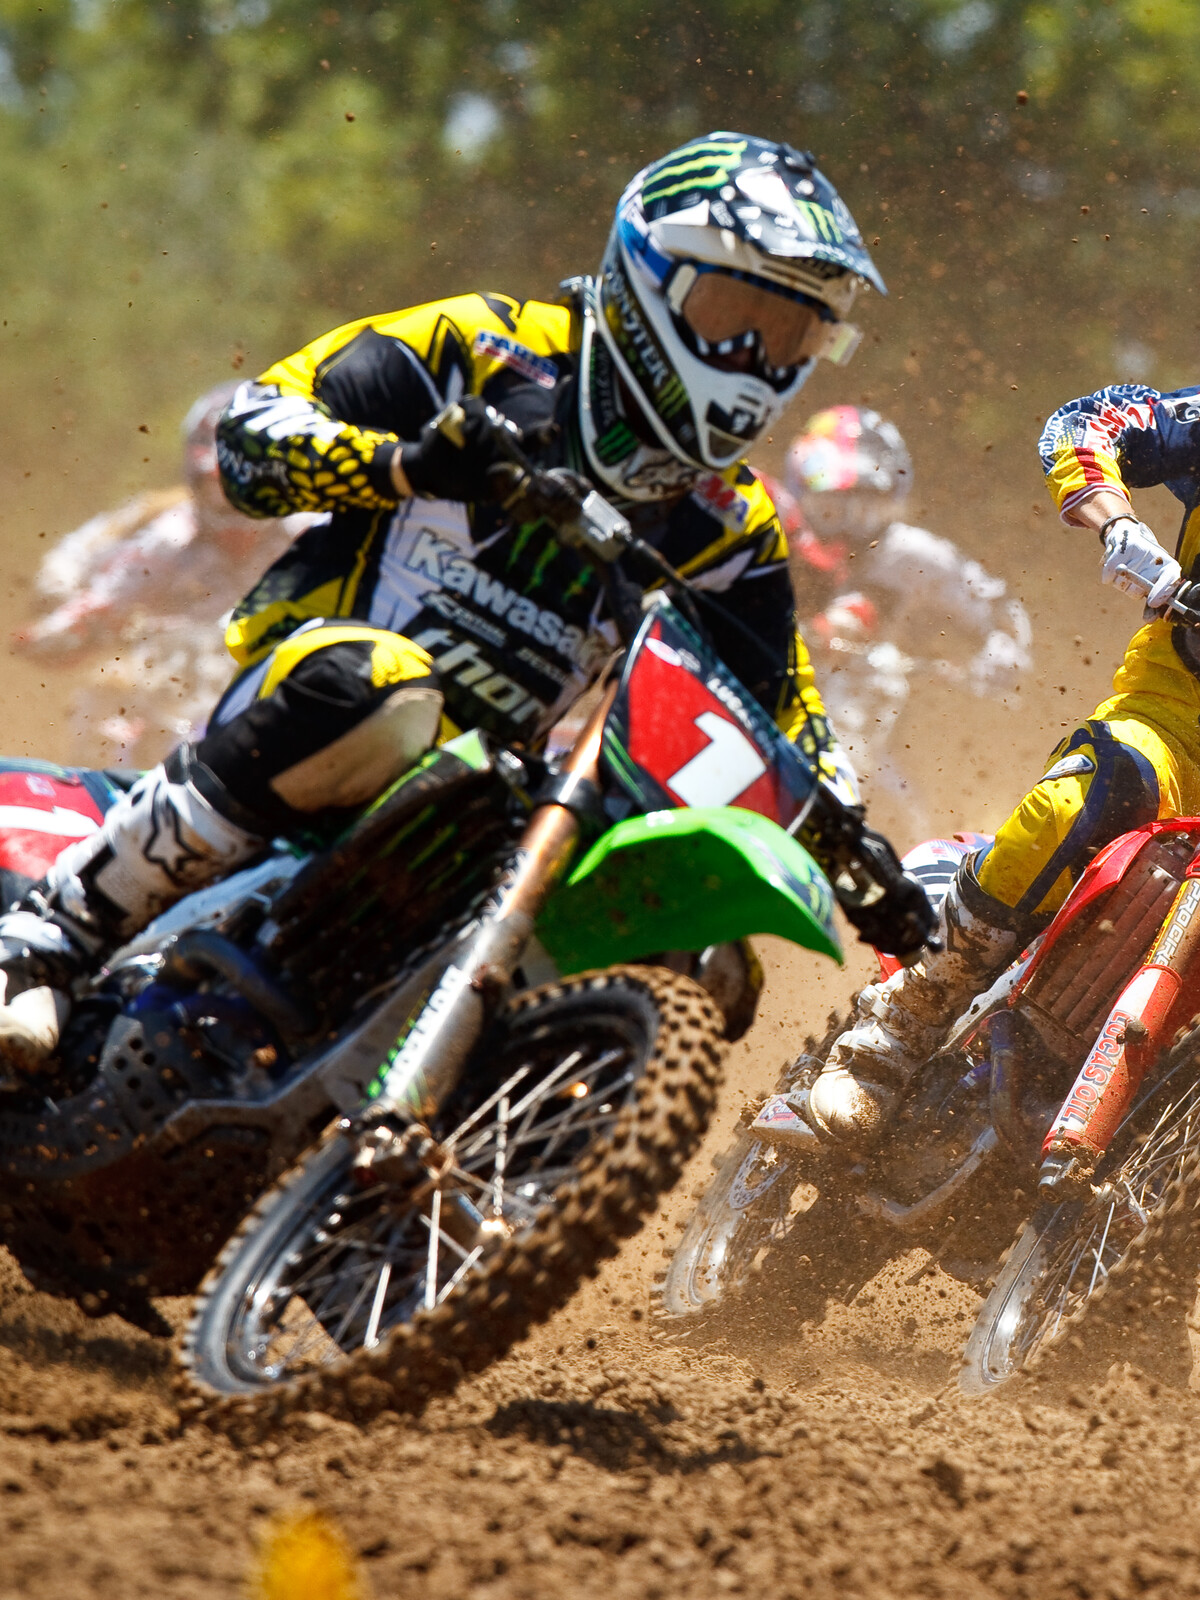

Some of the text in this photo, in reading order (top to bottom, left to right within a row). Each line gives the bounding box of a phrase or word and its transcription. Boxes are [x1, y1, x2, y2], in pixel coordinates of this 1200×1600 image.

[407, 527, 588, 660] Kawasa
[667, 711, 766, 808] 1
[1152, 925, 1185, 966] CIRC
[1061, 1009, 1128, 1124] LUCAS OIL
